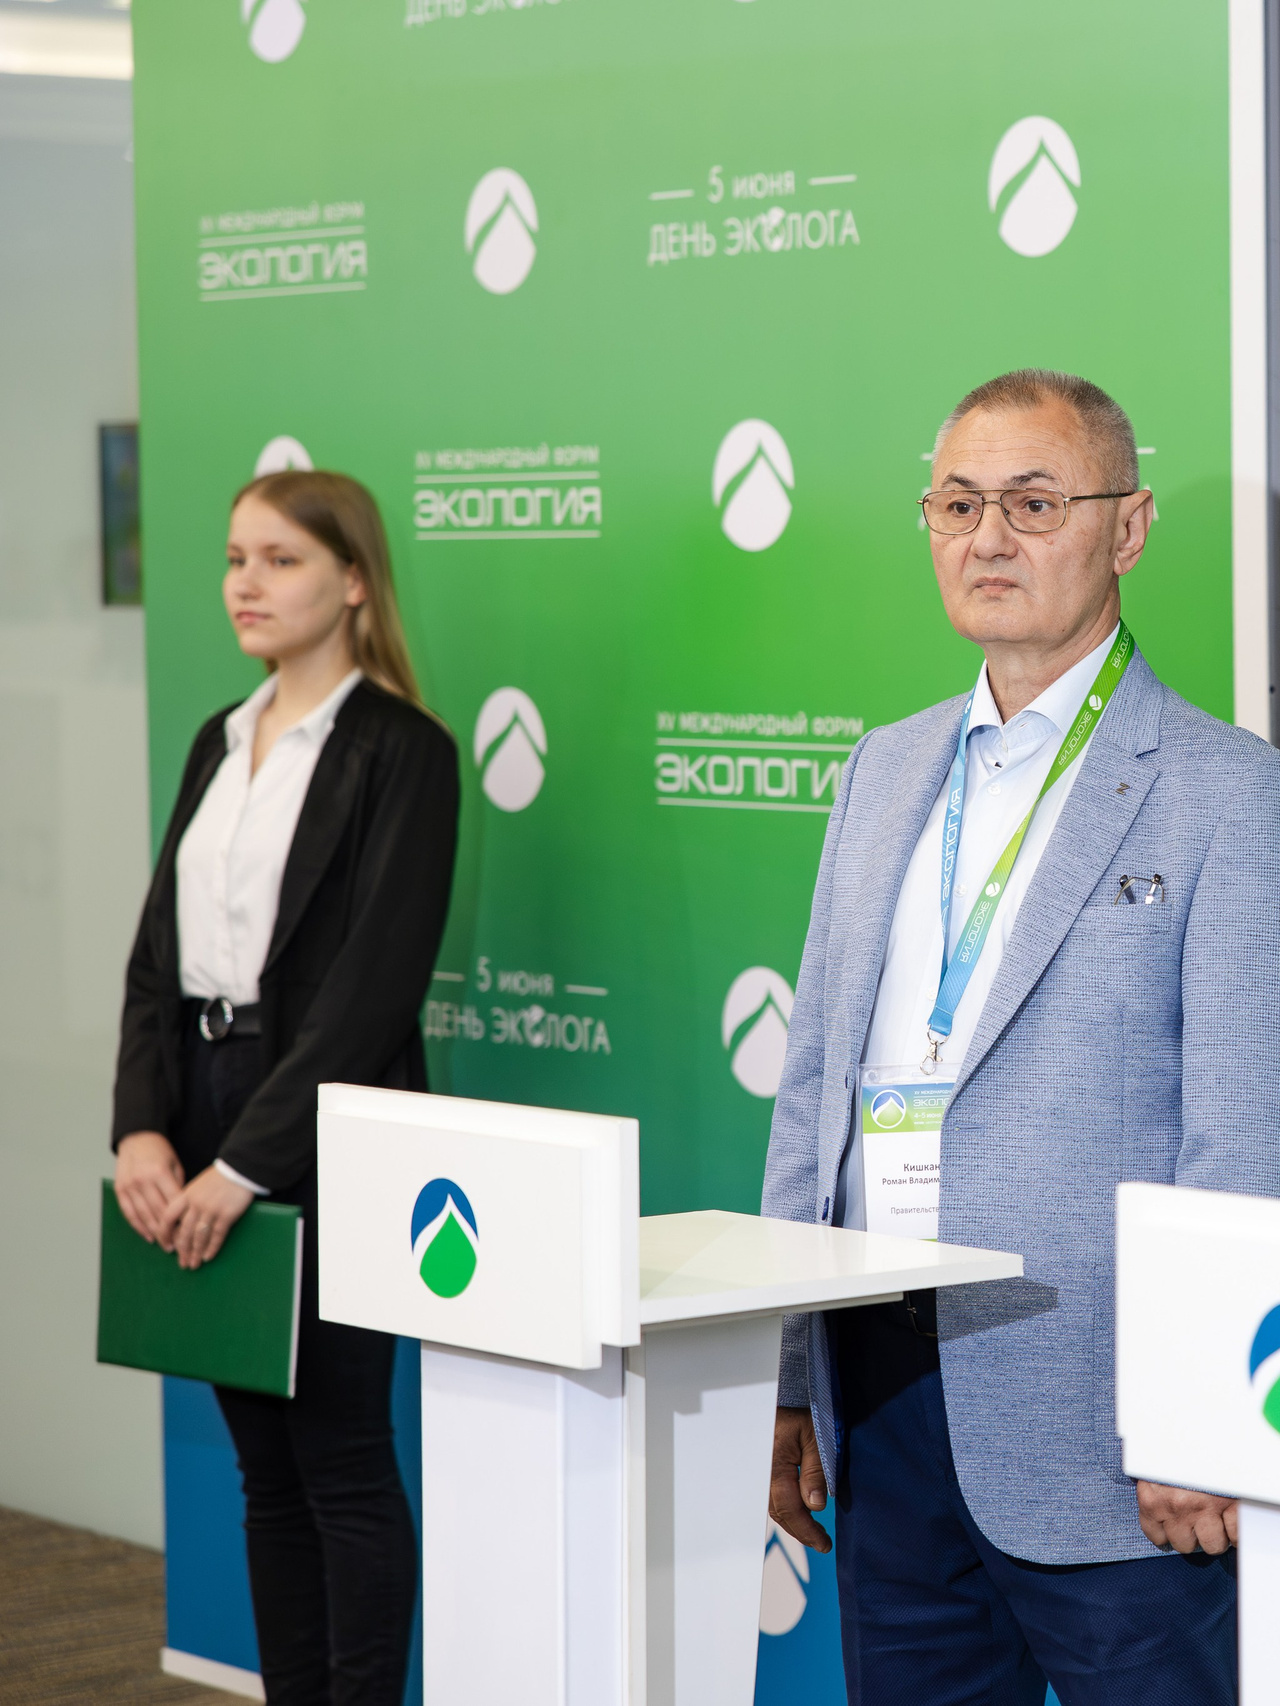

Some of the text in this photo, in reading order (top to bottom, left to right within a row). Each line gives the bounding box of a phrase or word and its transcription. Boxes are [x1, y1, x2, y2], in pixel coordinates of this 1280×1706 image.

[707, 165, 796, 204] 5 июня
[647, 206, 861, 267] ДЕНЬ ЭКОЛОГА
[198, 240, 368, 289] ЭКОЛОГИЯ
[413, 486, 602, 528] ЭКОЛОГИЯ
[1058, 711, 1092, 766] ЭКОЛОГИЯ
[654, 753, 847, 799] ЭКОЛОГИ
[943, 787, 961, 901] ЭКОЛОГИЯ
[960, 901, 990, 963] ЭКОЛОГИЯ
[476, 955, 492, 993] 5
[882, 1177, 907, 1186] Роман
